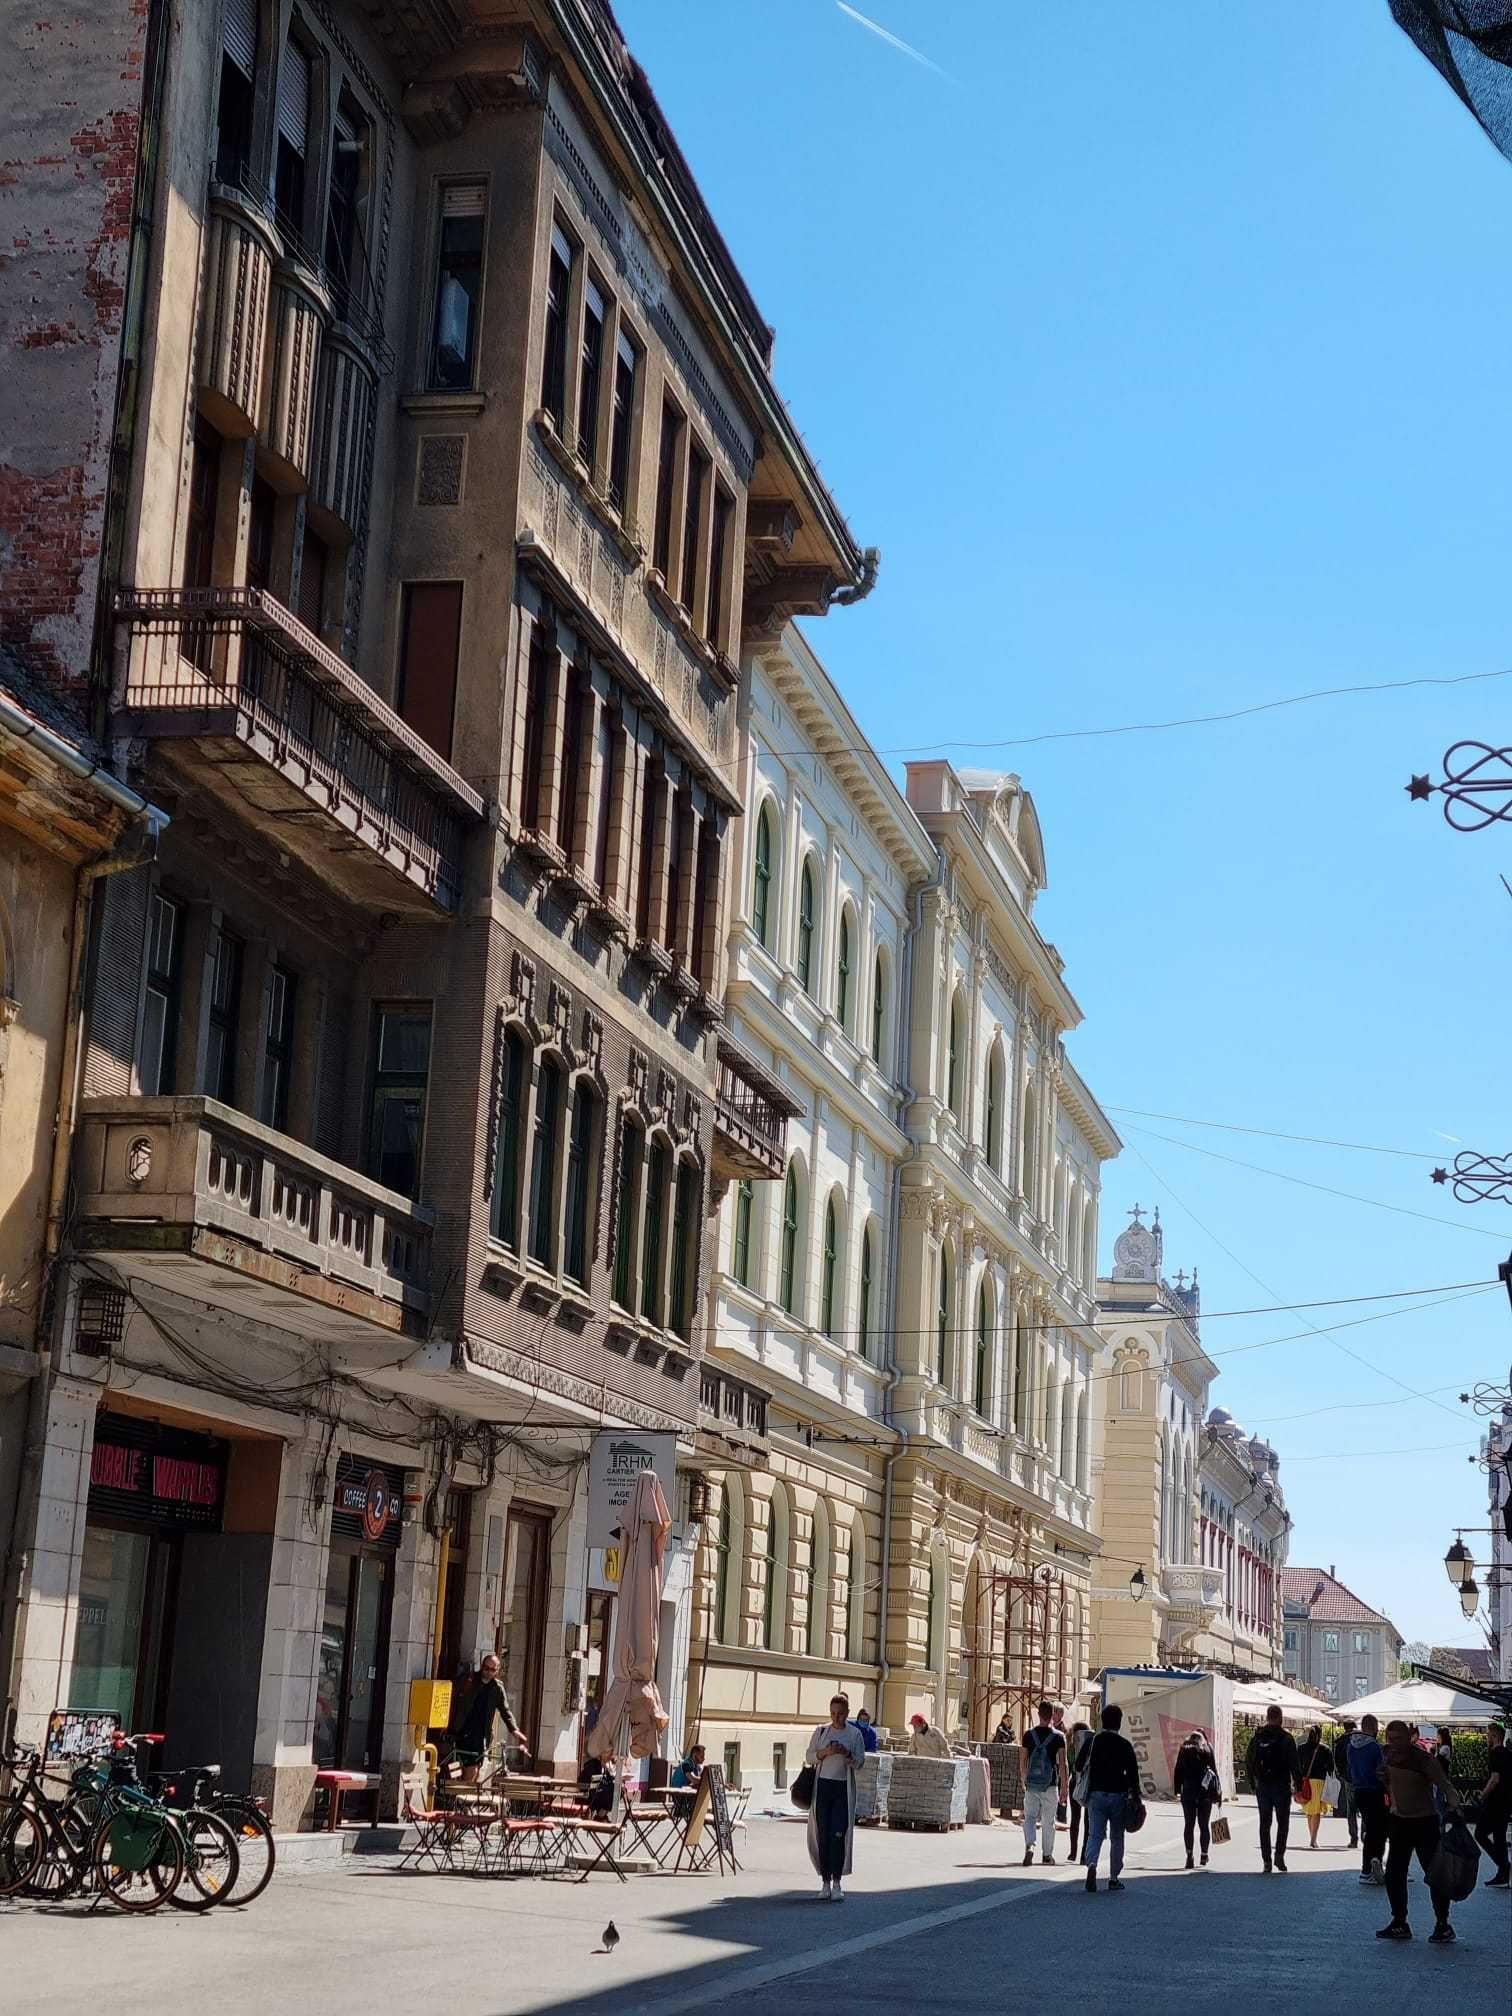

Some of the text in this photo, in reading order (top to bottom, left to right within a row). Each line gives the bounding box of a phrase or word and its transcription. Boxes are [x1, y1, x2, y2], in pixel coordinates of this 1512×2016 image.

[606, 1468, 635, 1476] CARTIER
[343, 1486, 400, 1518] COFFEE 2 GO
